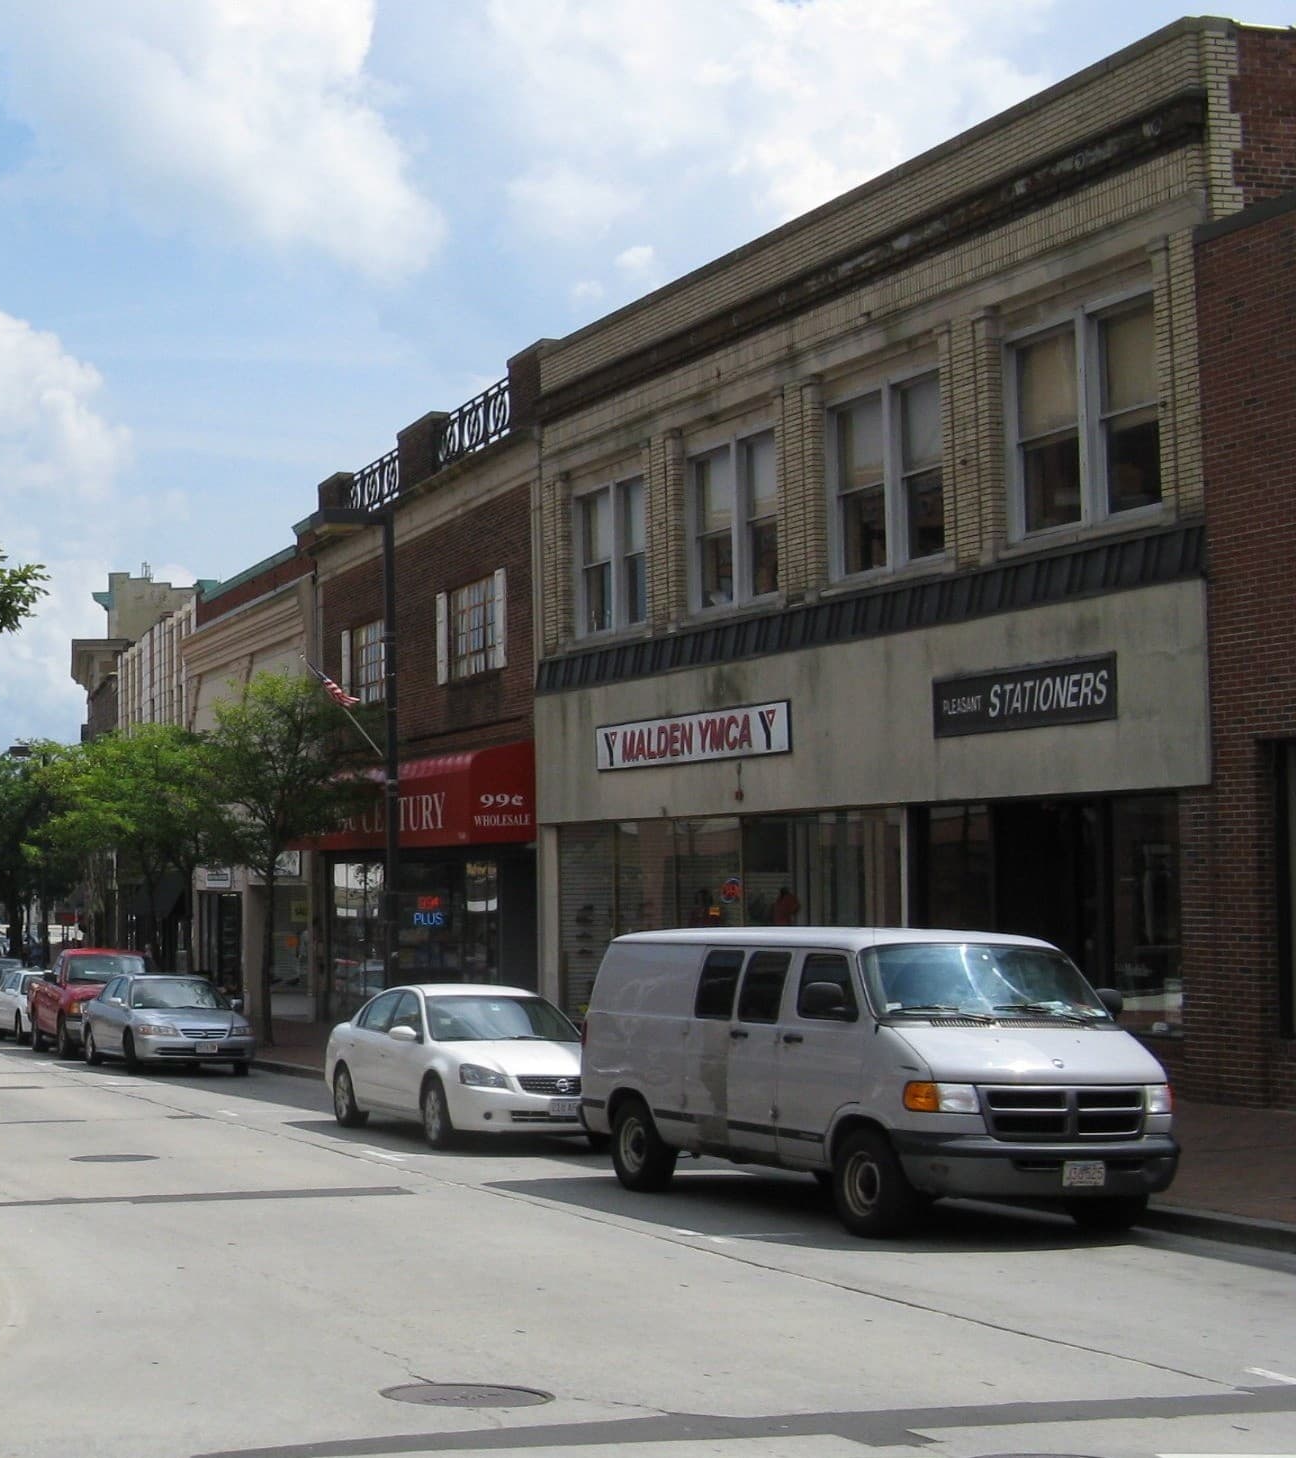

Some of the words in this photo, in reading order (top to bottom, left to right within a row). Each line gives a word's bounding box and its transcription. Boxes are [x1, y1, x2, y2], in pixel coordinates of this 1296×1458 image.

[943, 695, 982, 715] PLEASANT
[988, 670, 1108, 718] STATIONERS
[621, 722, 694, 763] MALDEN
[698, 714, 753, 753] YMCA
[362, 792, 445, 834] CETURY
[479, 793, 524, 808] 99¢
[474, 814, 530, 827] WHOLESALE
[414, 912, 442, 926] PLUS
